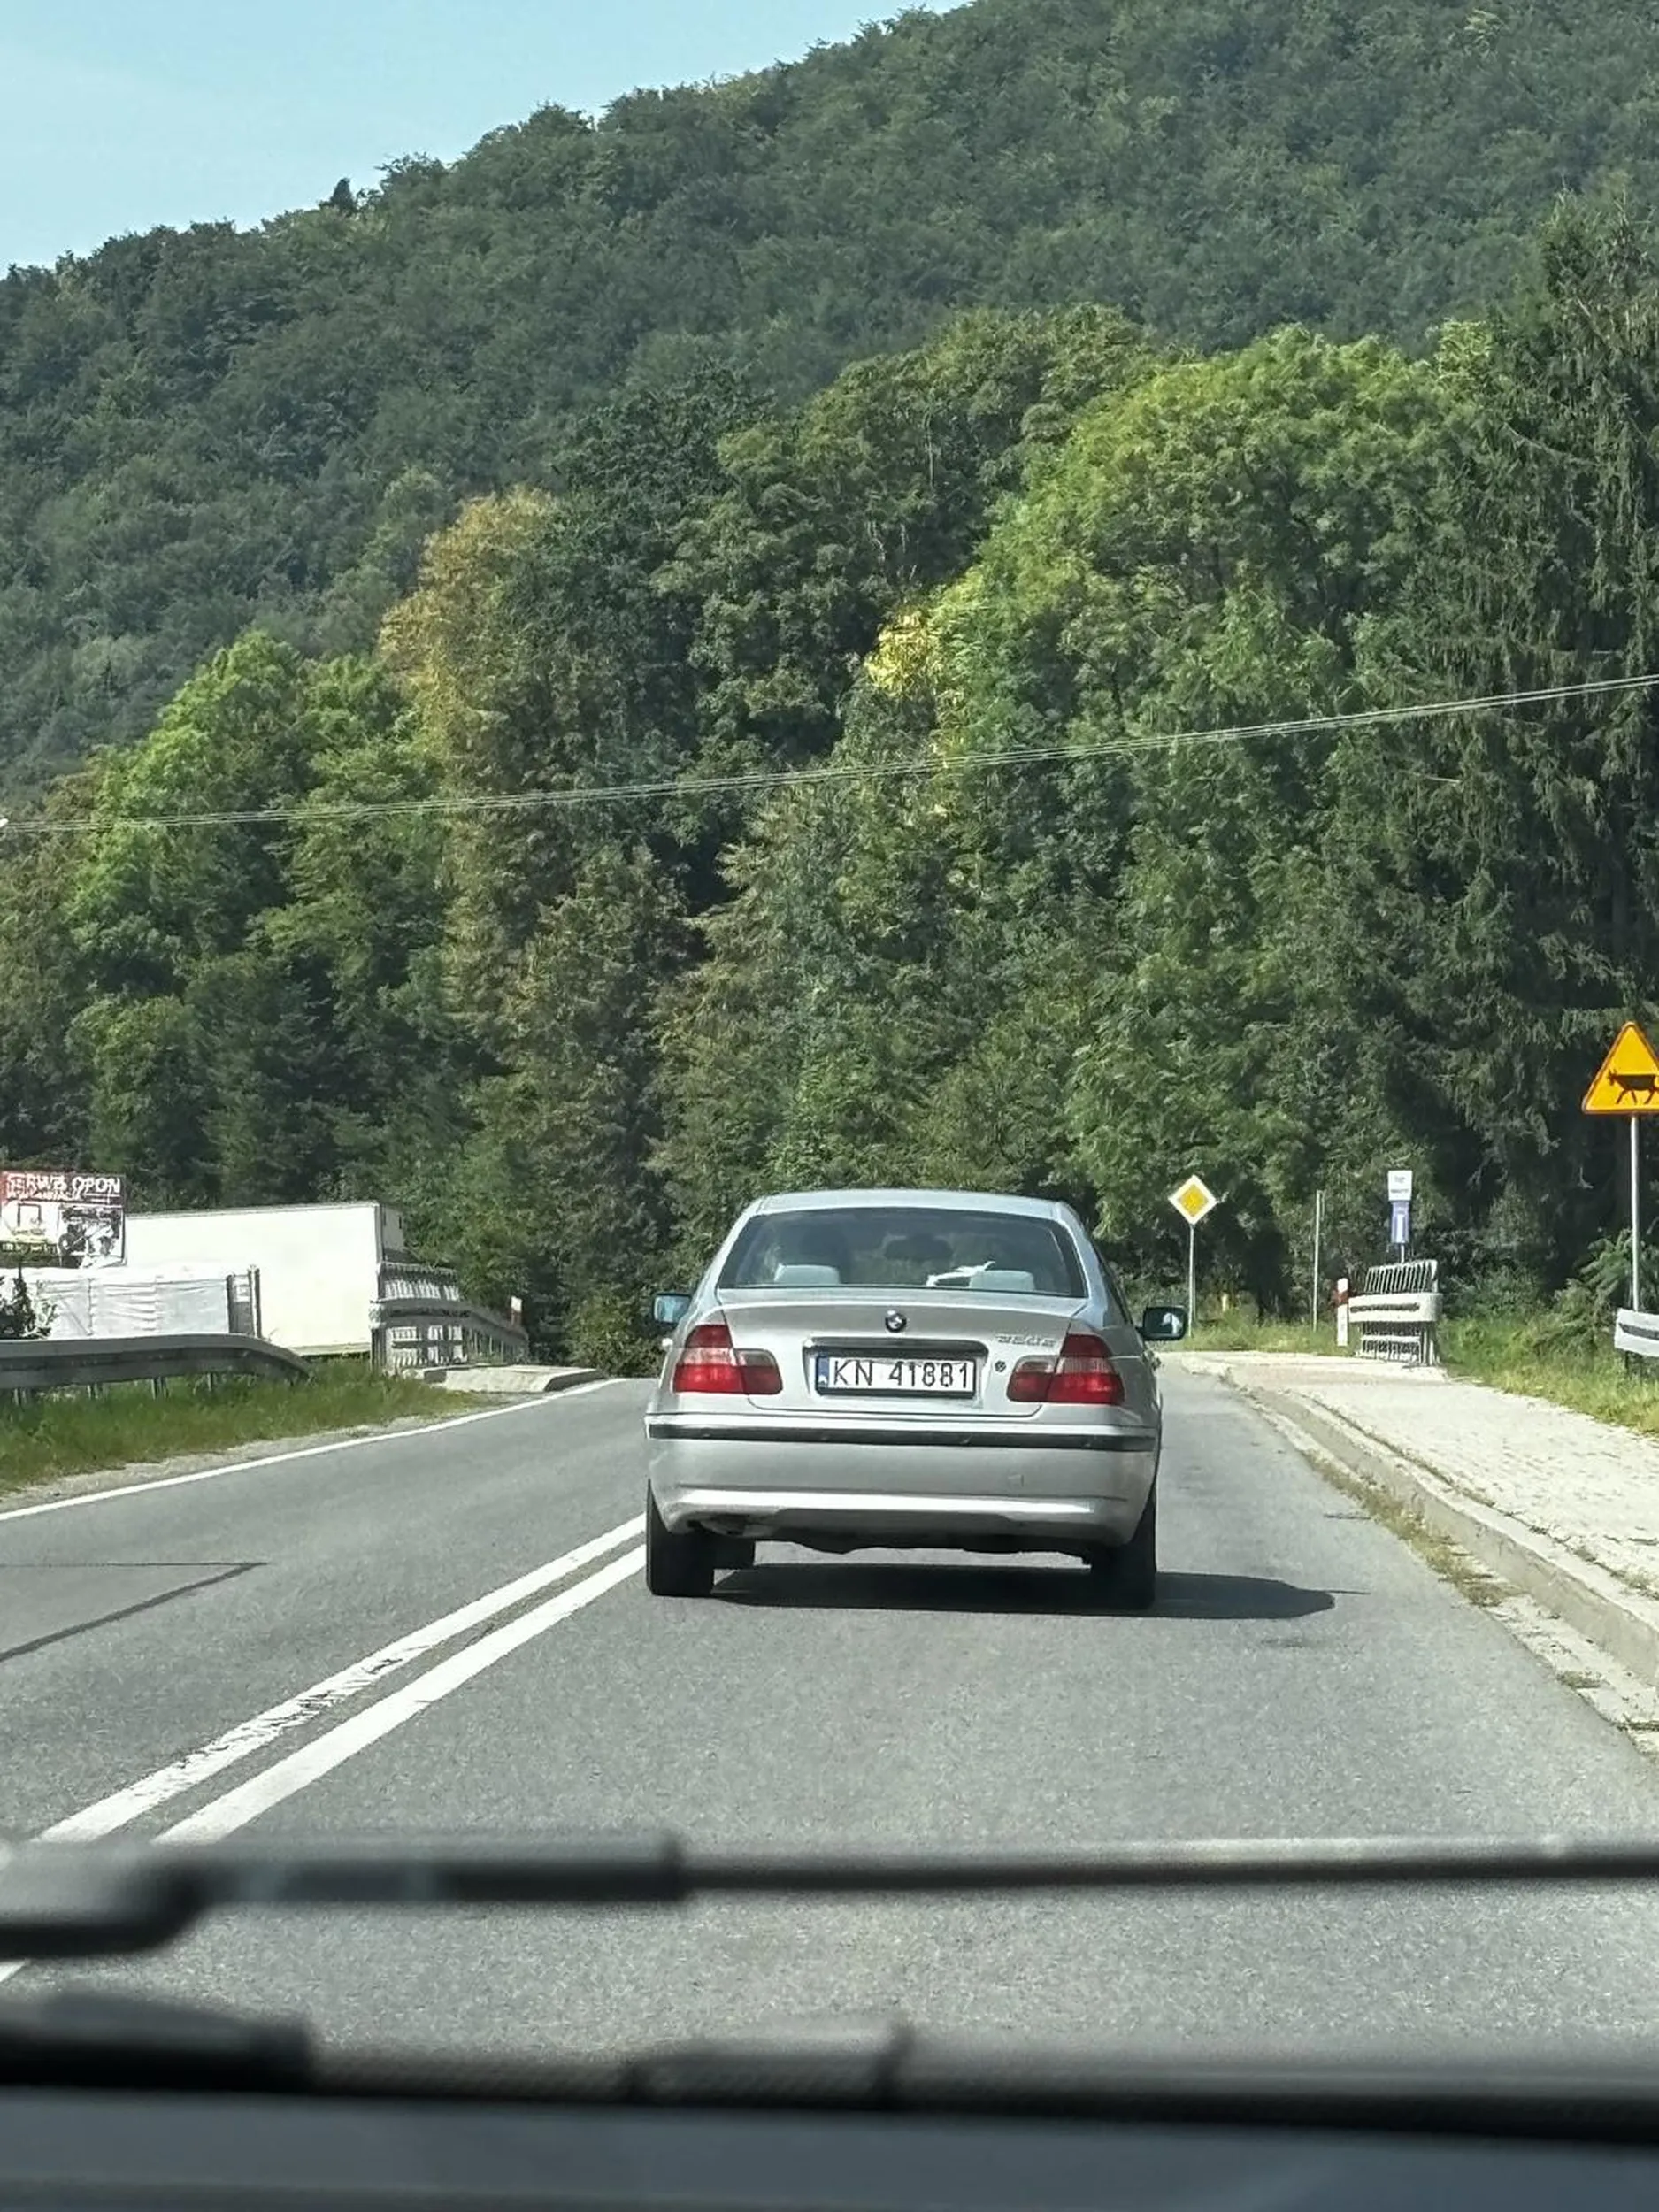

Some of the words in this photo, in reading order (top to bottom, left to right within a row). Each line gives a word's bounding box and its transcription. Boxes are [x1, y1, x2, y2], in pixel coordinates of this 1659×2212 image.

[72, 1176, 120, 1193] OPON
[833, 1360, 873, 1386] KN
[888, 1361, 968, 1388] 41881
